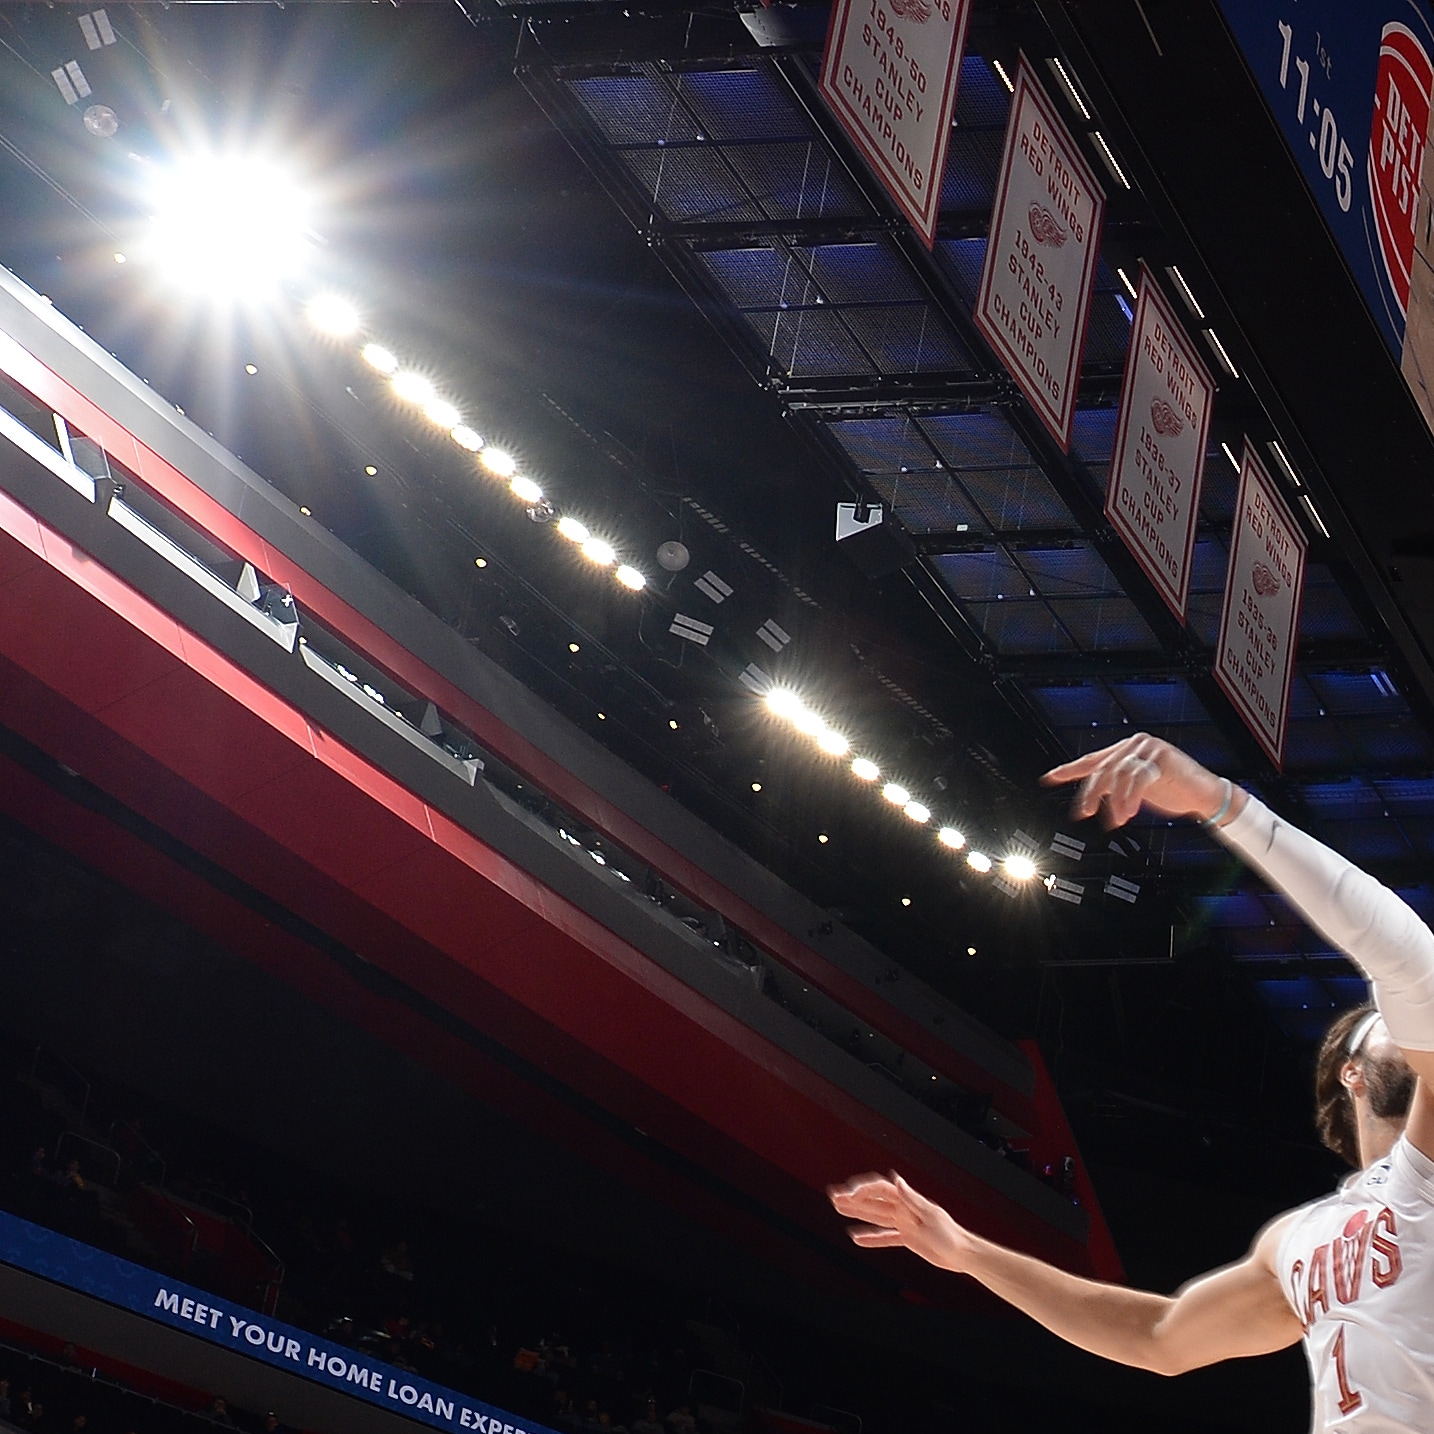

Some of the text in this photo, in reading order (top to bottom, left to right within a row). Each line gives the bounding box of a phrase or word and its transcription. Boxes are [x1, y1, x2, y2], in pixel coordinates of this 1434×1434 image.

[862, 23, 924, 123] STANLEY
[869, 2, 927, 94] 1949-50
[843, 65, 923, 190] CHAMPIONS
[875, 77, 903, 121] CUP
[1278, 19, 1353, 212] 11:05
[1020, 133, 1084, 243] RED WINGS
[1032, 121, 1081, 205] DETROIT
[1008, 254, 1061, 339] STANLEY
[1015, 230, 1063, 311] 1942-43
[994, 294, 1060, 400] CHAMPIONS
[1019, 302, 1043, 340] CUP
[1154, 322, 1195, 396] DETROIT
[1144, 335, 1198, 430] RED WINGS
[1135, 449, 1180, 521] STANLEY
[1143, 491, 1164, 525] CUP
[1255, 493, 1290, 556] DETROIT
[1121, 487, 1179, 578] CHAMPIONS
[1246, 505, 1293, 588] RED WINGS
[1237, 611, 1277, 676] STANLEY
[1246, 649, 1264, 679] CUP
[1227, 647, 1277, 728] CHAMPIONS
[154, 1287, 224, 1329] MEET
[229, 1315, 301, 1361] YOUR
[307, 1346, 383, 1393] HOME
[387, 1377, 454, 1421] LOAN
[1331, 1323, 1364, 1417] 1
